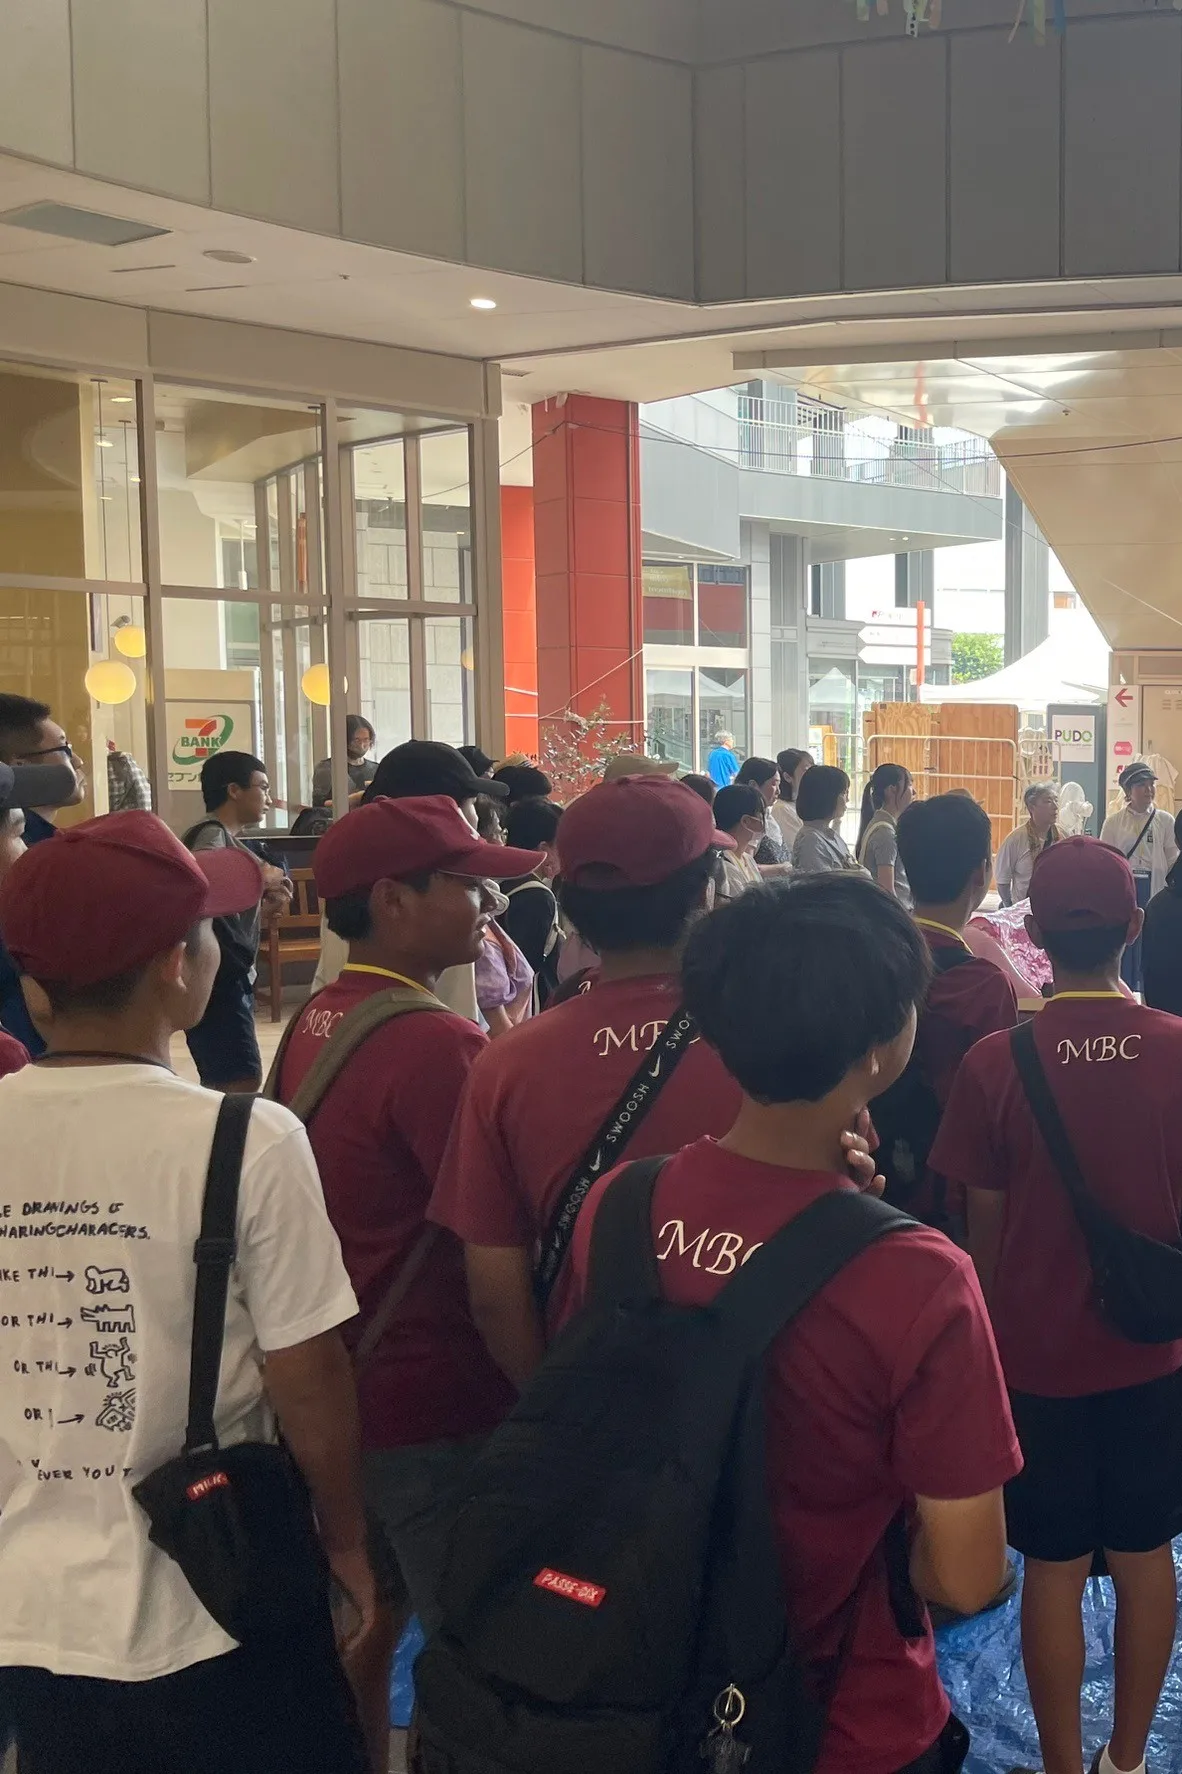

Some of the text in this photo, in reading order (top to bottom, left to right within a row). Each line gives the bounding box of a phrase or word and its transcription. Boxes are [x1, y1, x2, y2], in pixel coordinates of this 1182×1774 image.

[181, 736, 221, 748] BANK
[1054, 729, 1093, 742] PUDO
[302, 1008, 344, 1038] MBC
[1057, 1034, 1142, 1064] MBC
[606, 1083, 650, 1143] SWOOSH
[1, 1315, 20, 1327] OR
[14, 1360, 30, 1374] OR
[24, 1407, 42, 1421] OR
[82, 1465, 115, 1480] YOU
